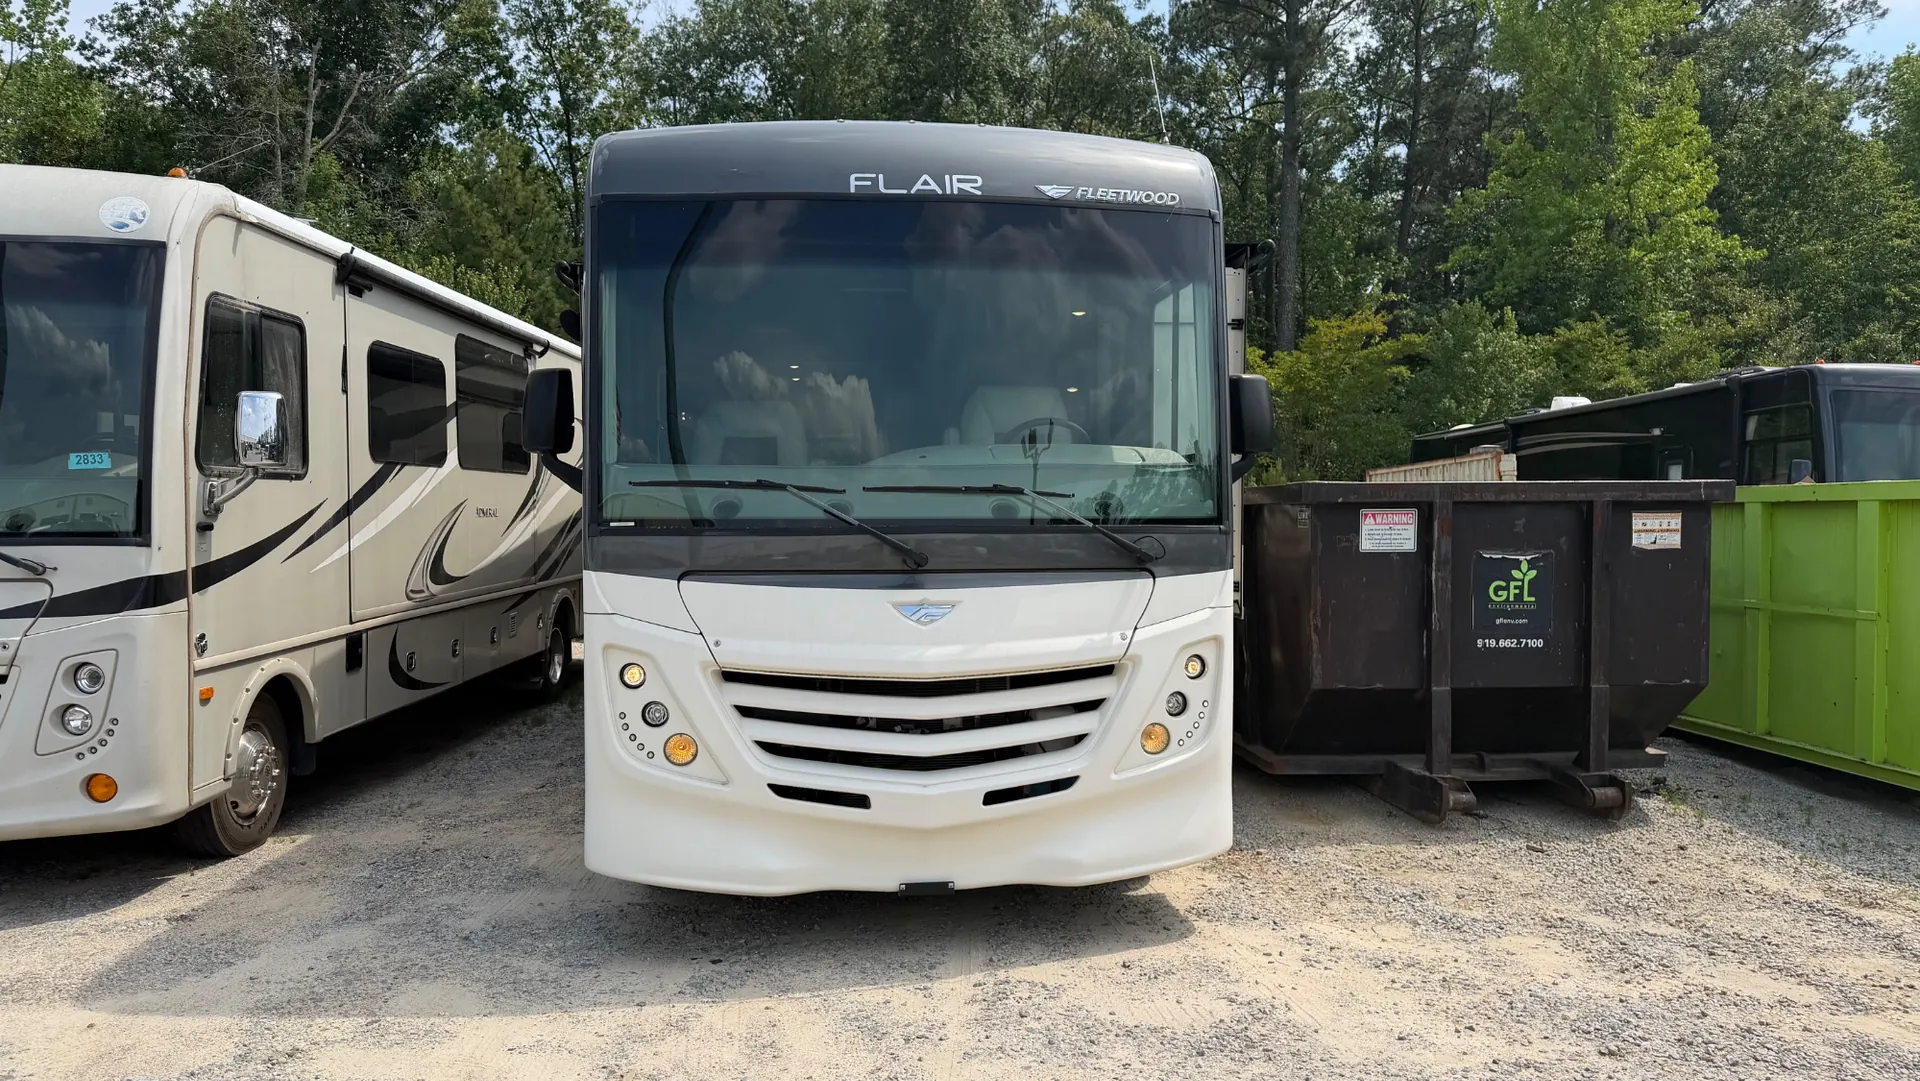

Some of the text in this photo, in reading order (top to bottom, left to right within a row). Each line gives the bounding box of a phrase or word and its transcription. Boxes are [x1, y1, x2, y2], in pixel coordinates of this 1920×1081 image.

[849, 173, 983, 196] FLAIR
[1075, 186, 1180, 206] FLEETWOOD
[75, 453, 104, 465] 2833
[1375, 513, 1413, 525] WARNING
[1488, 575, 1536, 602] GFL
[1476, 638, 1544, 648] 919.662.7100
